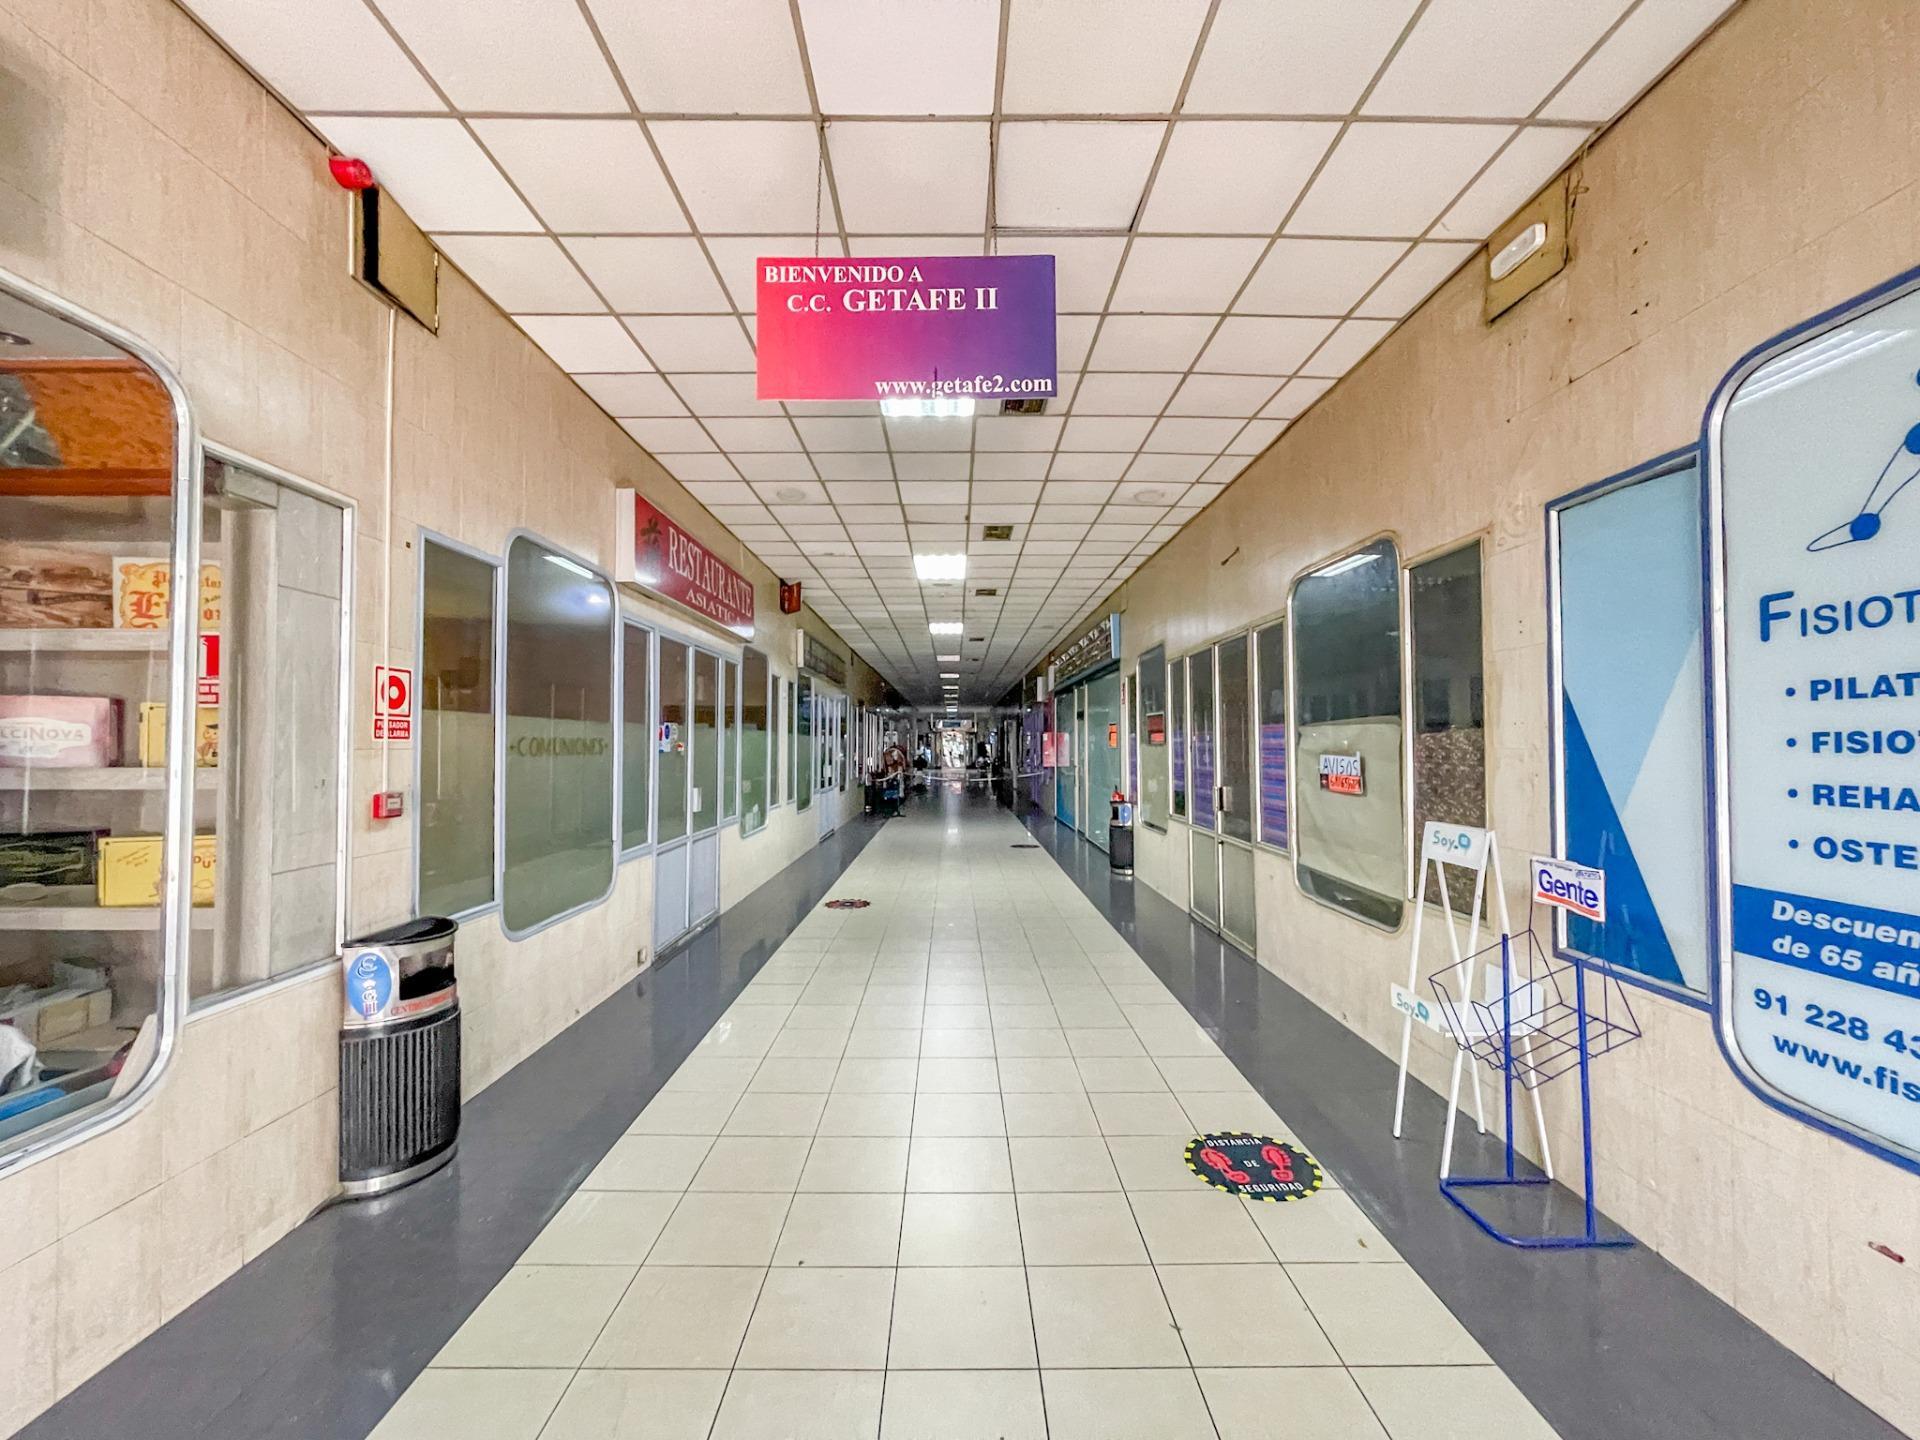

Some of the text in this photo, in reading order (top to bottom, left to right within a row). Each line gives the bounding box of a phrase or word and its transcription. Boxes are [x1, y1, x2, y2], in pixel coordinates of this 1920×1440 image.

[764, 265, 924, 284] BIENVENIDO A
[787, 287, 998, 313] C.C. GETAFE II
[875, 375, 1053, 398] www.getafe2.com
[668, 526, 753, 618] RESTAURANTE
[1760, 591, 1920, 642] FISIOT
[1811, 729, 1920, 754] FISIO
[1812, 783, 1920, 813] REHA
[1813, 836, 1918, 870] OSTE
[1538, 869, 1599, 908] Gente
[1772, 935, 1920, 987] de 65 añ
[1754, 988, 1788, 1016] 91
[1805, 1003, 1869, 1041] 228
[1206, 1138, 1262, 1147] DISTANCIA
[1243, 1160, 1260, 1168] DE
[1238, 1182, 1304, 1194] SEGURIDAD
